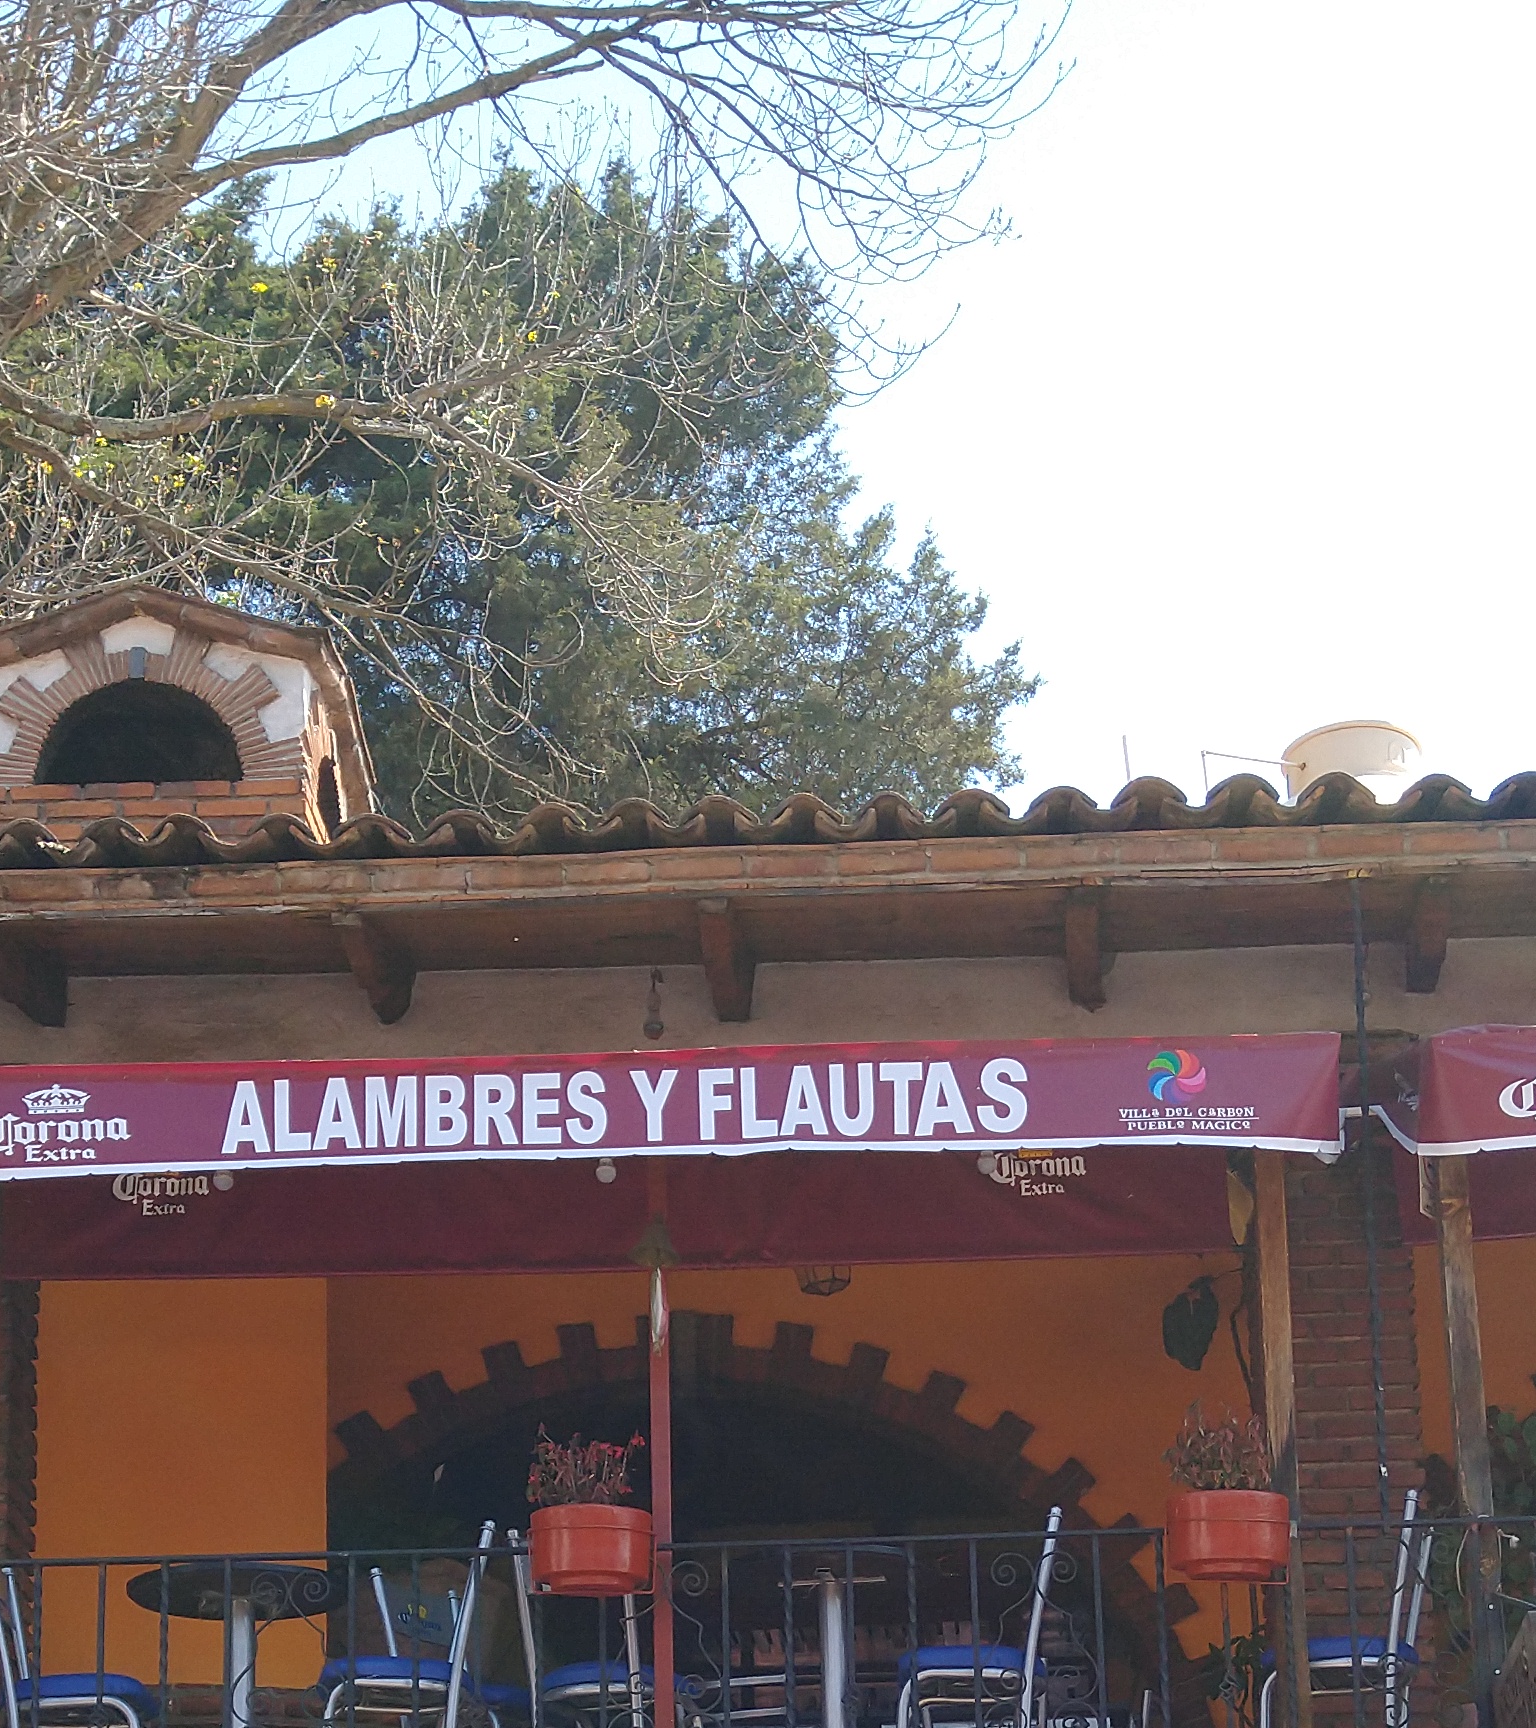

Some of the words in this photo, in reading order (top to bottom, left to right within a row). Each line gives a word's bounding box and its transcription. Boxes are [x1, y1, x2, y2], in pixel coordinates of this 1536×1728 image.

[221, 1070, 608, 1154] ALAMBRES
[629, 1069, 679, 1143] Y
[698, 1057, 1028, 1141] FLAUTAS
[25, 1143, 96, 1163] Extra
[989, 1153, 1086, 1187] Corona
[112, 1173, 209, 1205] Corona
[1020, 1179, 1064, 1196] Extra
[142, 1198, 185, 1216] Extra
